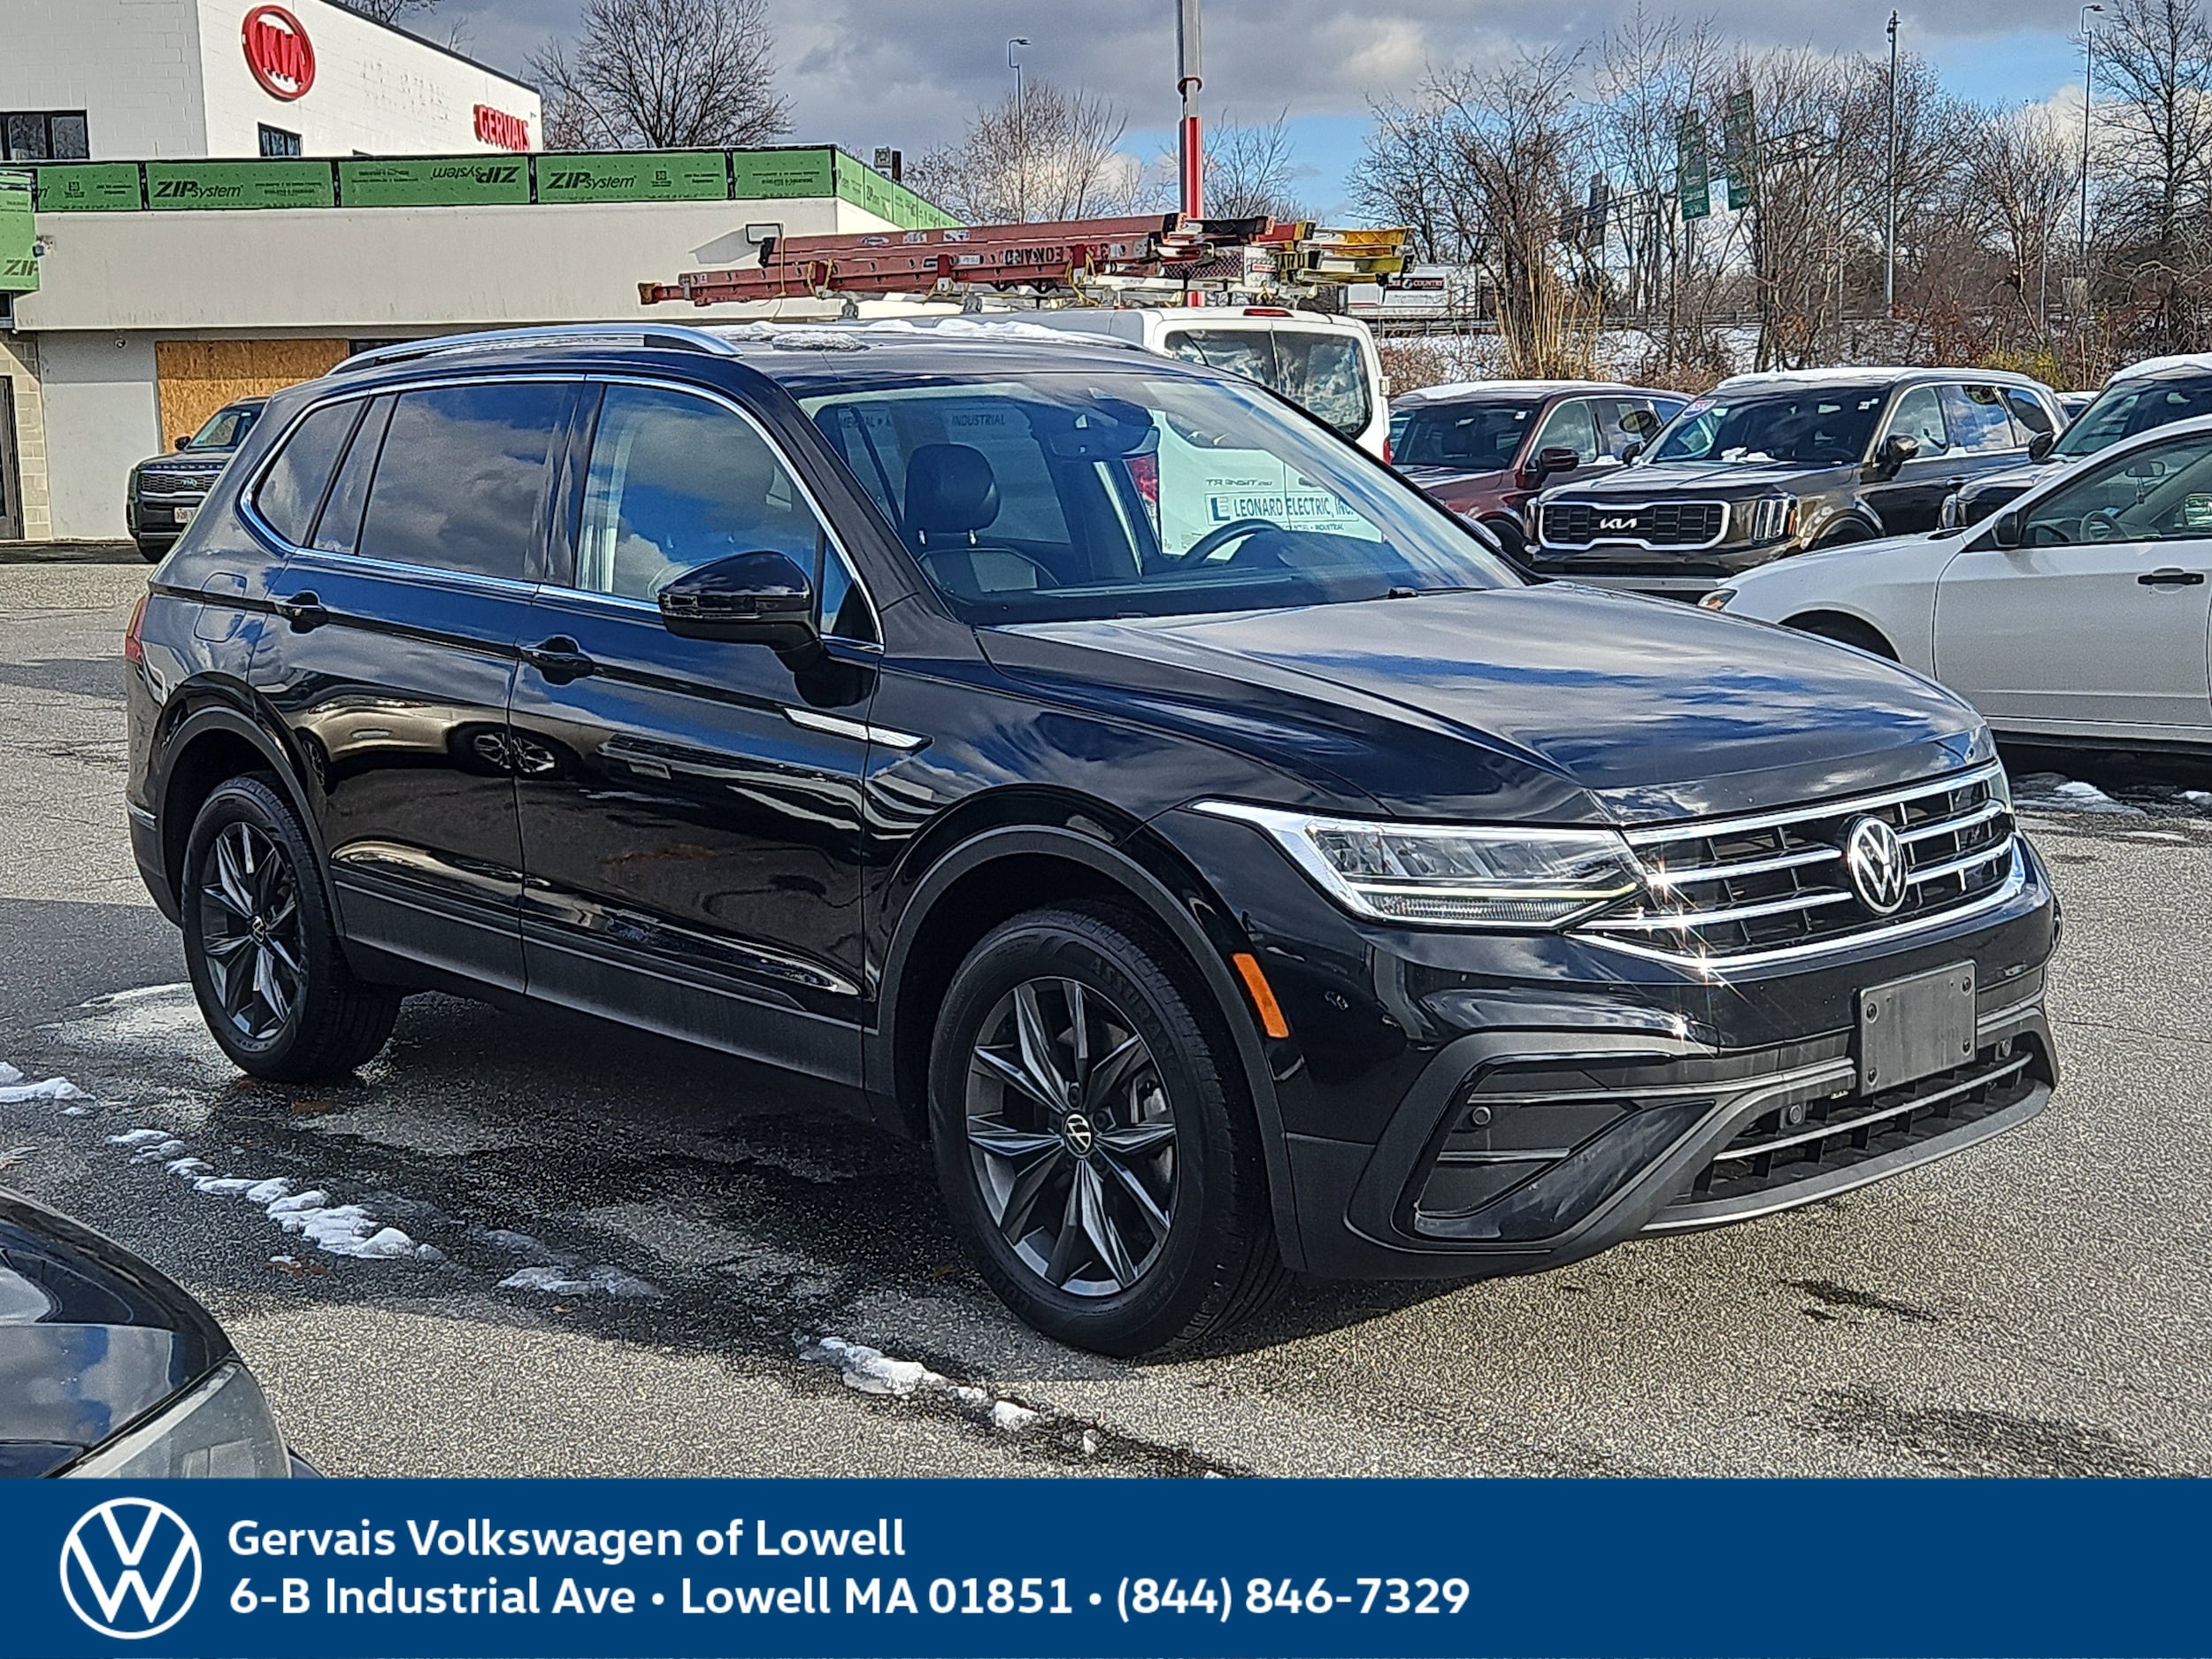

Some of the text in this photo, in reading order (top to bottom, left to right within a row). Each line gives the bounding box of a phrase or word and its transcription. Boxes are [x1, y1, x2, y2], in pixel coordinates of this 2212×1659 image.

[473, 104, 530, 151] GERVAIS
[951, 413, 1006, 426] INDUSTRIAL
[1233, 497, 1283, 517] LEONARD
[1285, 496, 1334, 518] ELECTRIC,
